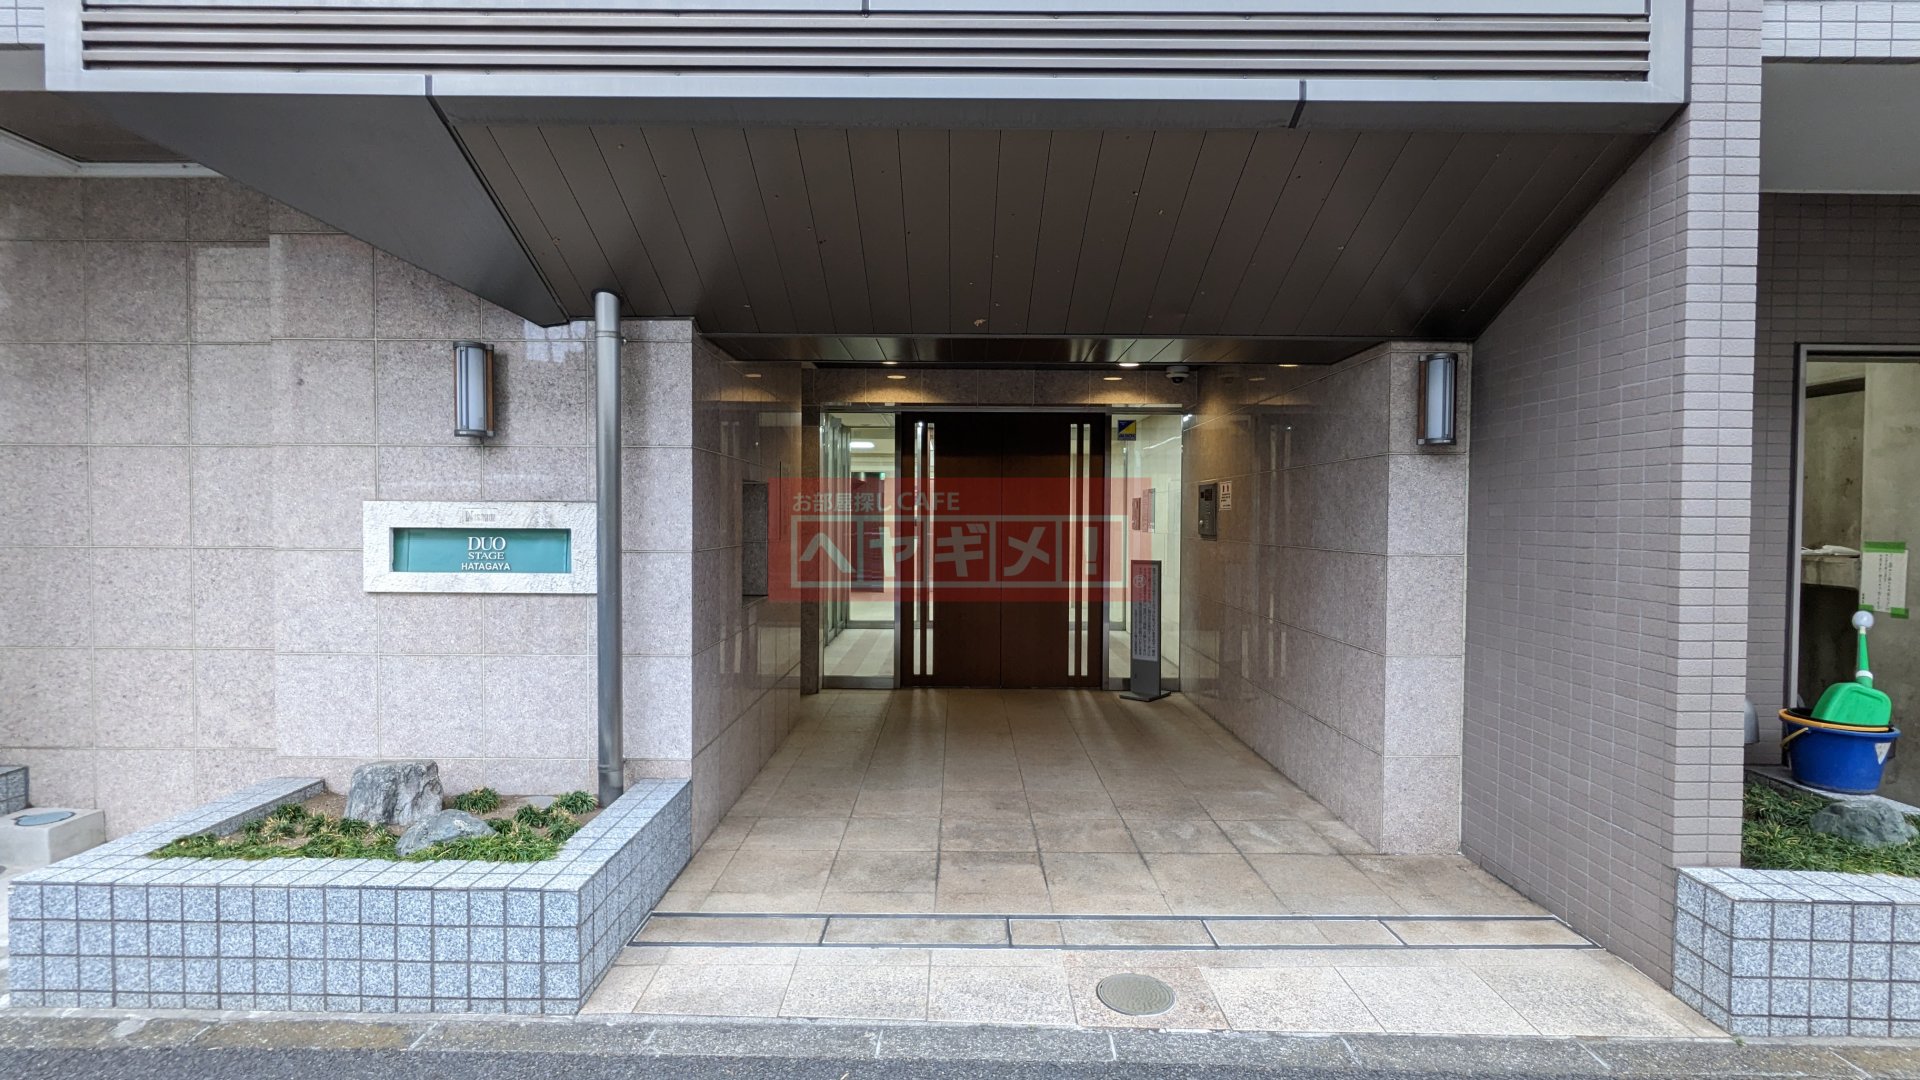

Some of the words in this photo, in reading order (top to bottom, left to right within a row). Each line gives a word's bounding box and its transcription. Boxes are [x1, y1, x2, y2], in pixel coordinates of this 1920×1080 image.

[467, 536, 506, 551] DUO
[467, 551, 505, 560] STAGE
[461, 562, 511, 571] HATAGAYA
